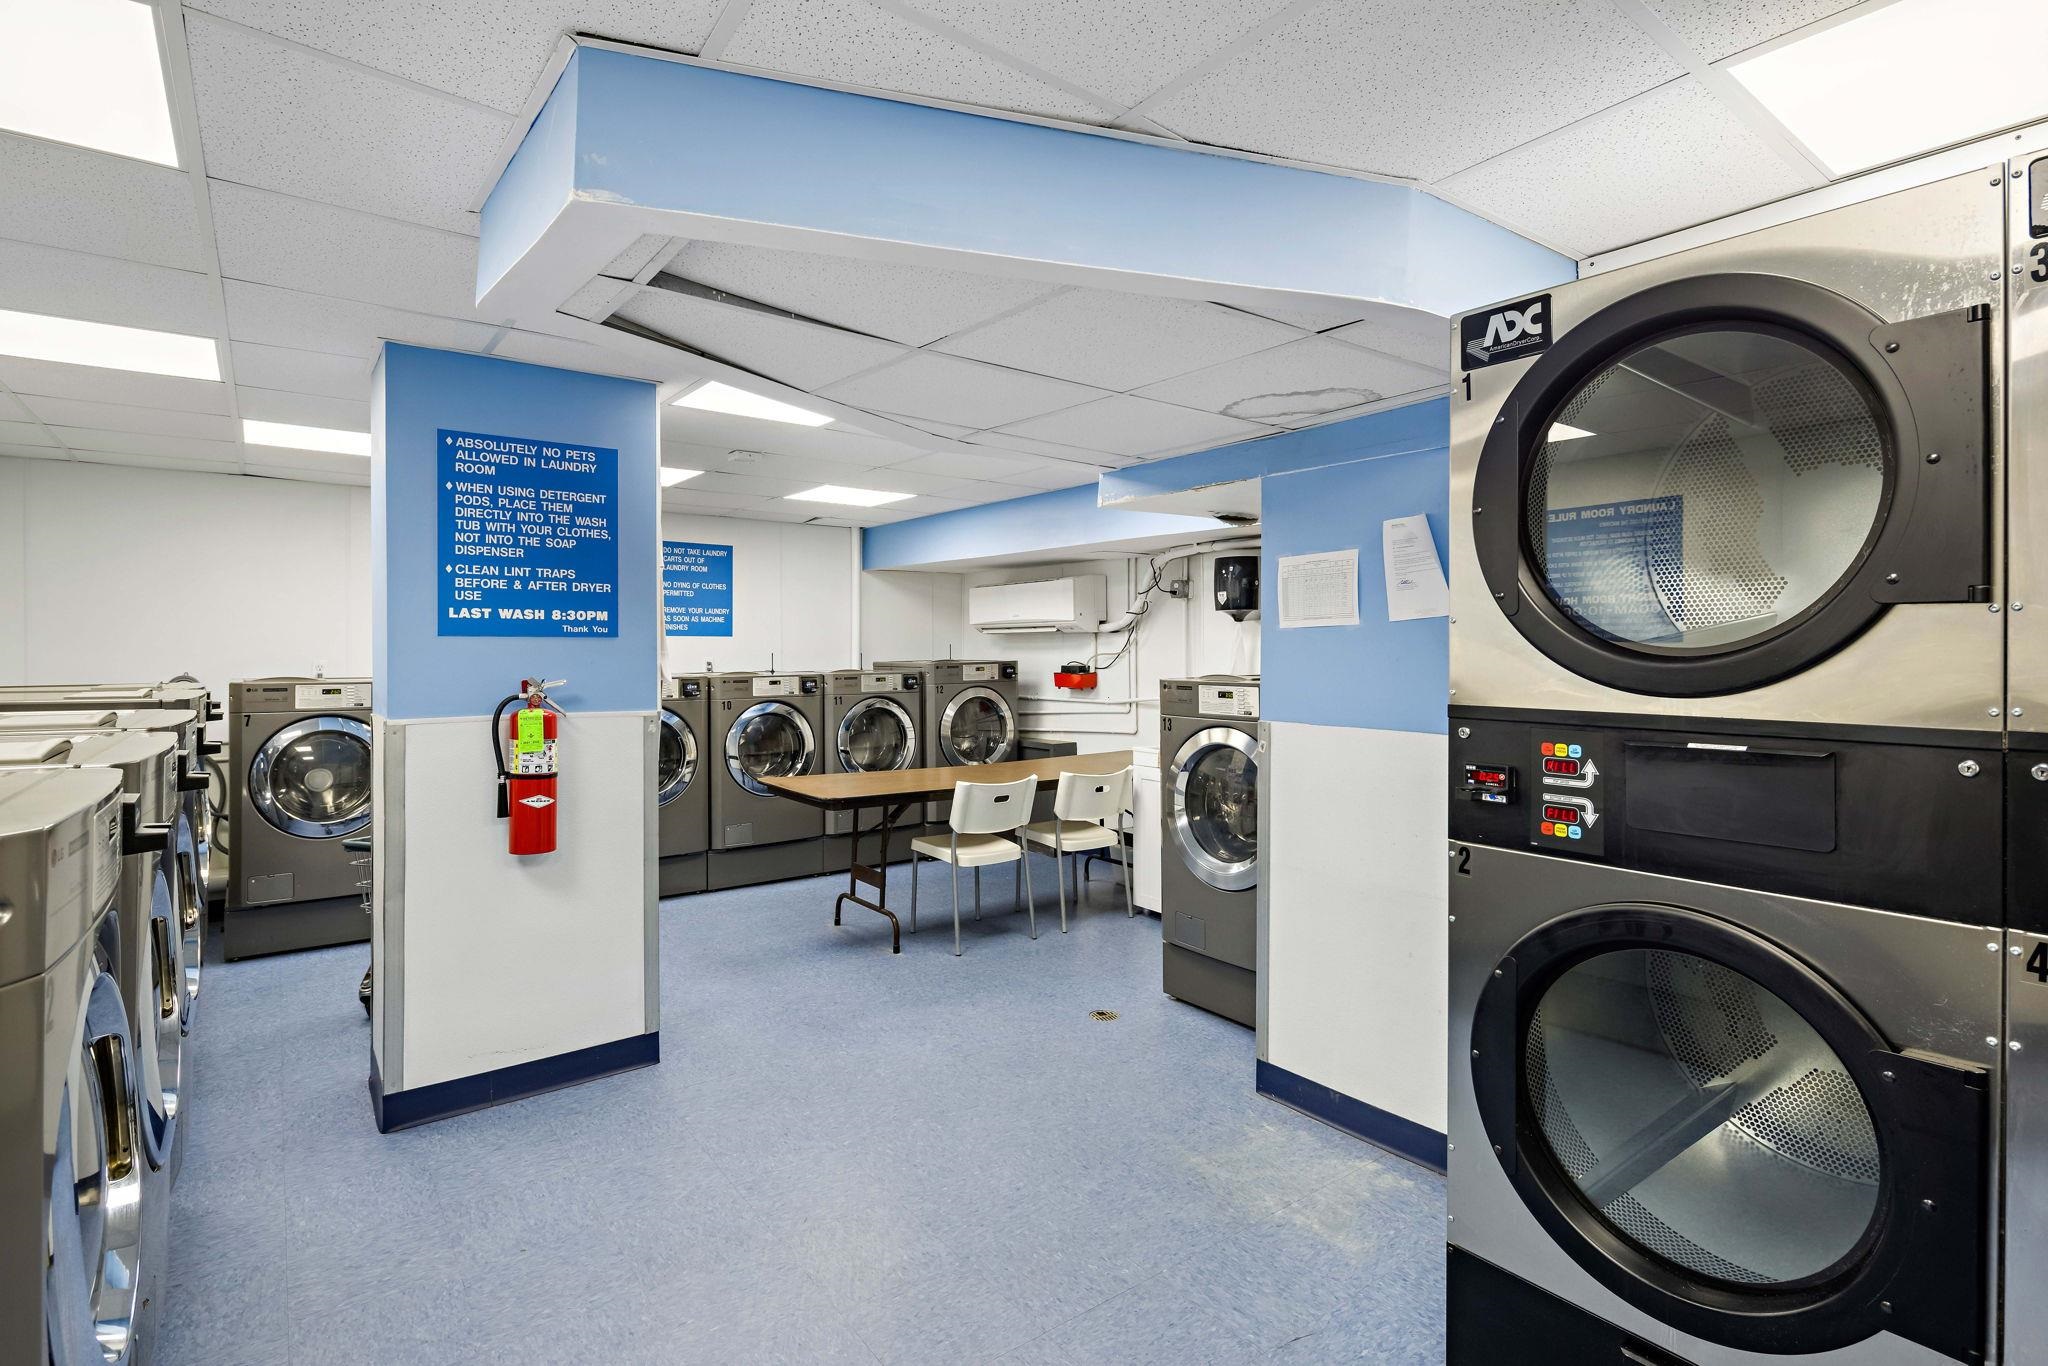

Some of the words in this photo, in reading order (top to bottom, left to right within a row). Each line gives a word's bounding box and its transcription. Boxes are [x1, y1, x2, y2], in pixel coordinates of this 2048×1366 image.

[2030, 242, 2048, 282] 3
[1484, 302, 1542, 347] ADC
[1462, 373, 1471, 401] 1
[456, 438, 537, 455] ABSOLUTELY
[543, 447, 560, 458] NO
[566, 450, 595, 461] PETS
[456, 450, 518, 465] ALLOWED
[524, 458, 536, 467] IN
[542, 459, 597, 473] LAUNDRY
[456, 463, 495, 475] ROOM
[456, 482, 492, 494] WHEN
[498, 486, 534, 497] USING
[540, 490, 606, 503] DETERGENT
[455, 495, 493, 508] PODS,
[499, 498, 536, 510] PLACE
[541, 502, 572, 513] THEM
[456, 507, 511, 520] DIRECTLY
[517, 512, 543, 522] INTO
[549, 514, 570, 524] THE
[576, 517, 606, 527] WASH
[456, 520, 480, 530] TUB
[486, 522, 515, 533] WITH
[521, 525, 552, 534] YOUR
[557, 527, 611, 541] CLOTHES,
[455, 533, 480, 542] NOT
[486, 534, 512, 545] INTO
[518, 536, 540, 546] THE
[546, 539, 576, 548] SOAP
[455, 545, 523, 557] DISPENSER
[455, 564, 498, 575] CLEAN
[505, 567, 530, 577] LINT
[536, 569, 575, 578] TRAPS
[455, 578, 507, 589] BEFORE
[514, 581, 522, 589] &
[528, 581, 567, 591] AFTER
[572, 583, 611, 592] DRYER
[455, 591, 481, 600] USE
[449, 608, 491, 618] LAST
[499, 609, 544, 619] WASH
[552, 610, 608, 621] 8:30PM
[936, 686, 944, 694] 12
[722, 700, 731, 710] 10
[834, 696, 842, 705] 11
[244, 714, 251, 727] 7
[1162, 718, 1172, 731] 13
[1458, 847, 1470, 875] 2
[2026, 942, 2048, 982] 4
